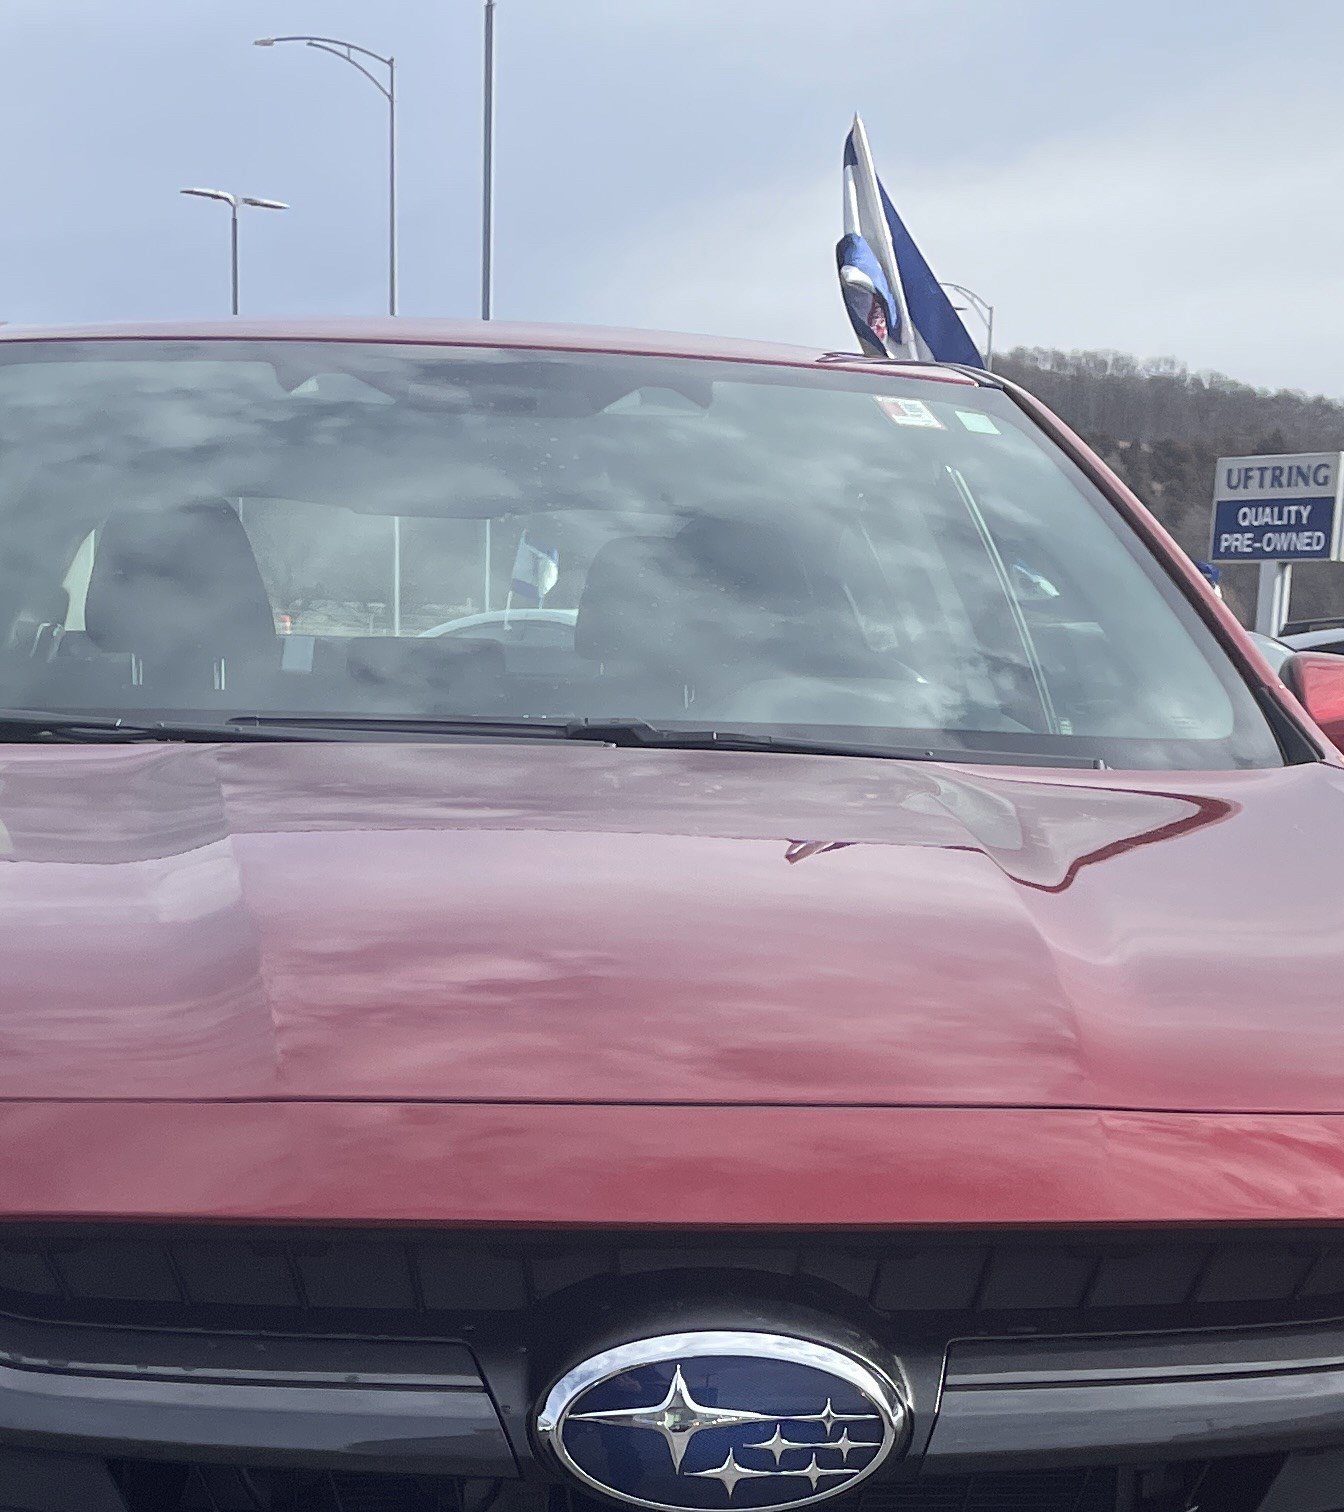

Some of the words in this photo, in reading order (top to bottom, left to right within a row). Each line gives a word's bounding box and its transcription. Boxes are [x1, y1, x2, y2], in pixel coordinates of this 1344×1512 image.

[1226, 463, 1330, 490] UFTRING
[1237, 505, 1312, 526] QUALITY
[1219, 531, 1325, 553] PRE-OWNED
